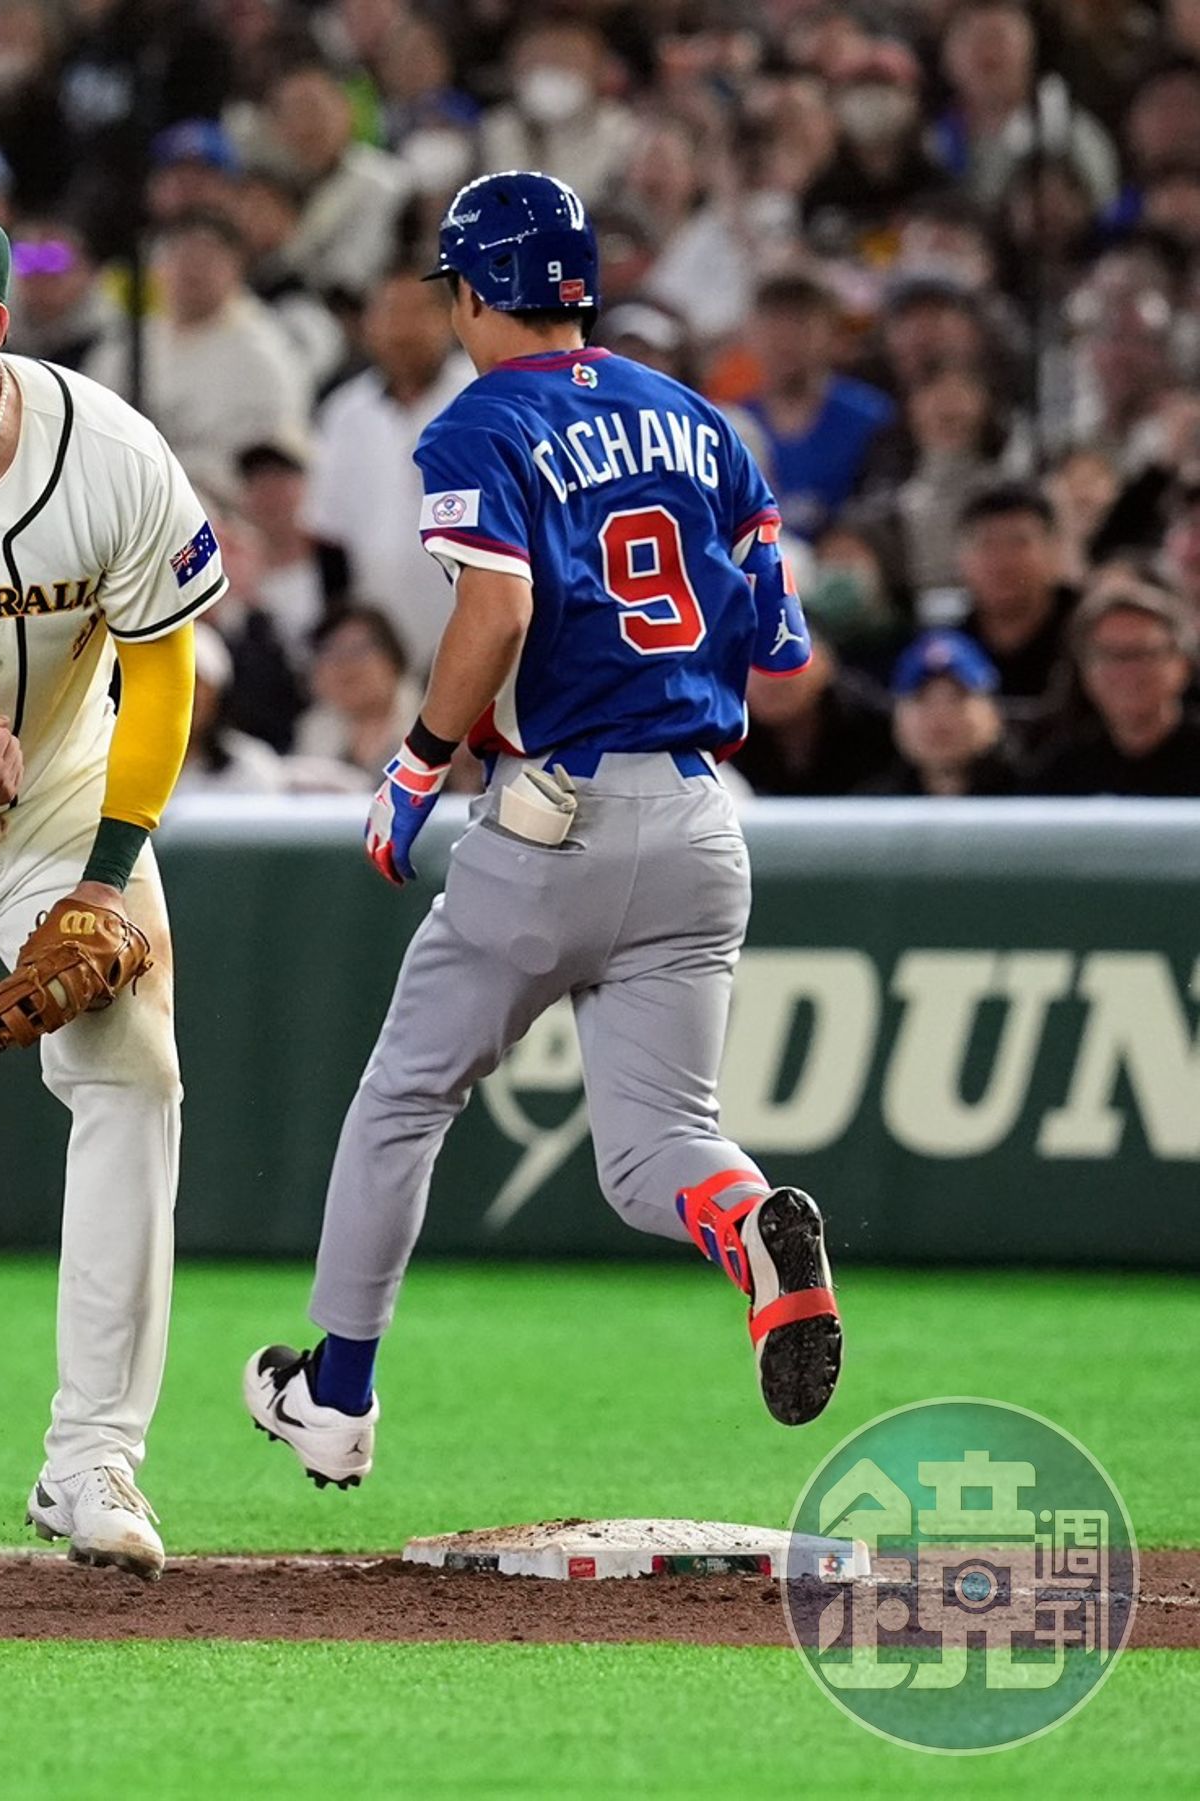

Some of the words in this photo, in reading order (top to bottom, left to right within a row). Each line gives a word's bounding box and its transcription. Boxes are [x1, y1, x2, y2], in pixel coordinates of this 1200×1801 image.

[547, 260, 562, 282] 9
[598, 505, 707, 654] 9
[716, 947, 1200, 1160] DUN
